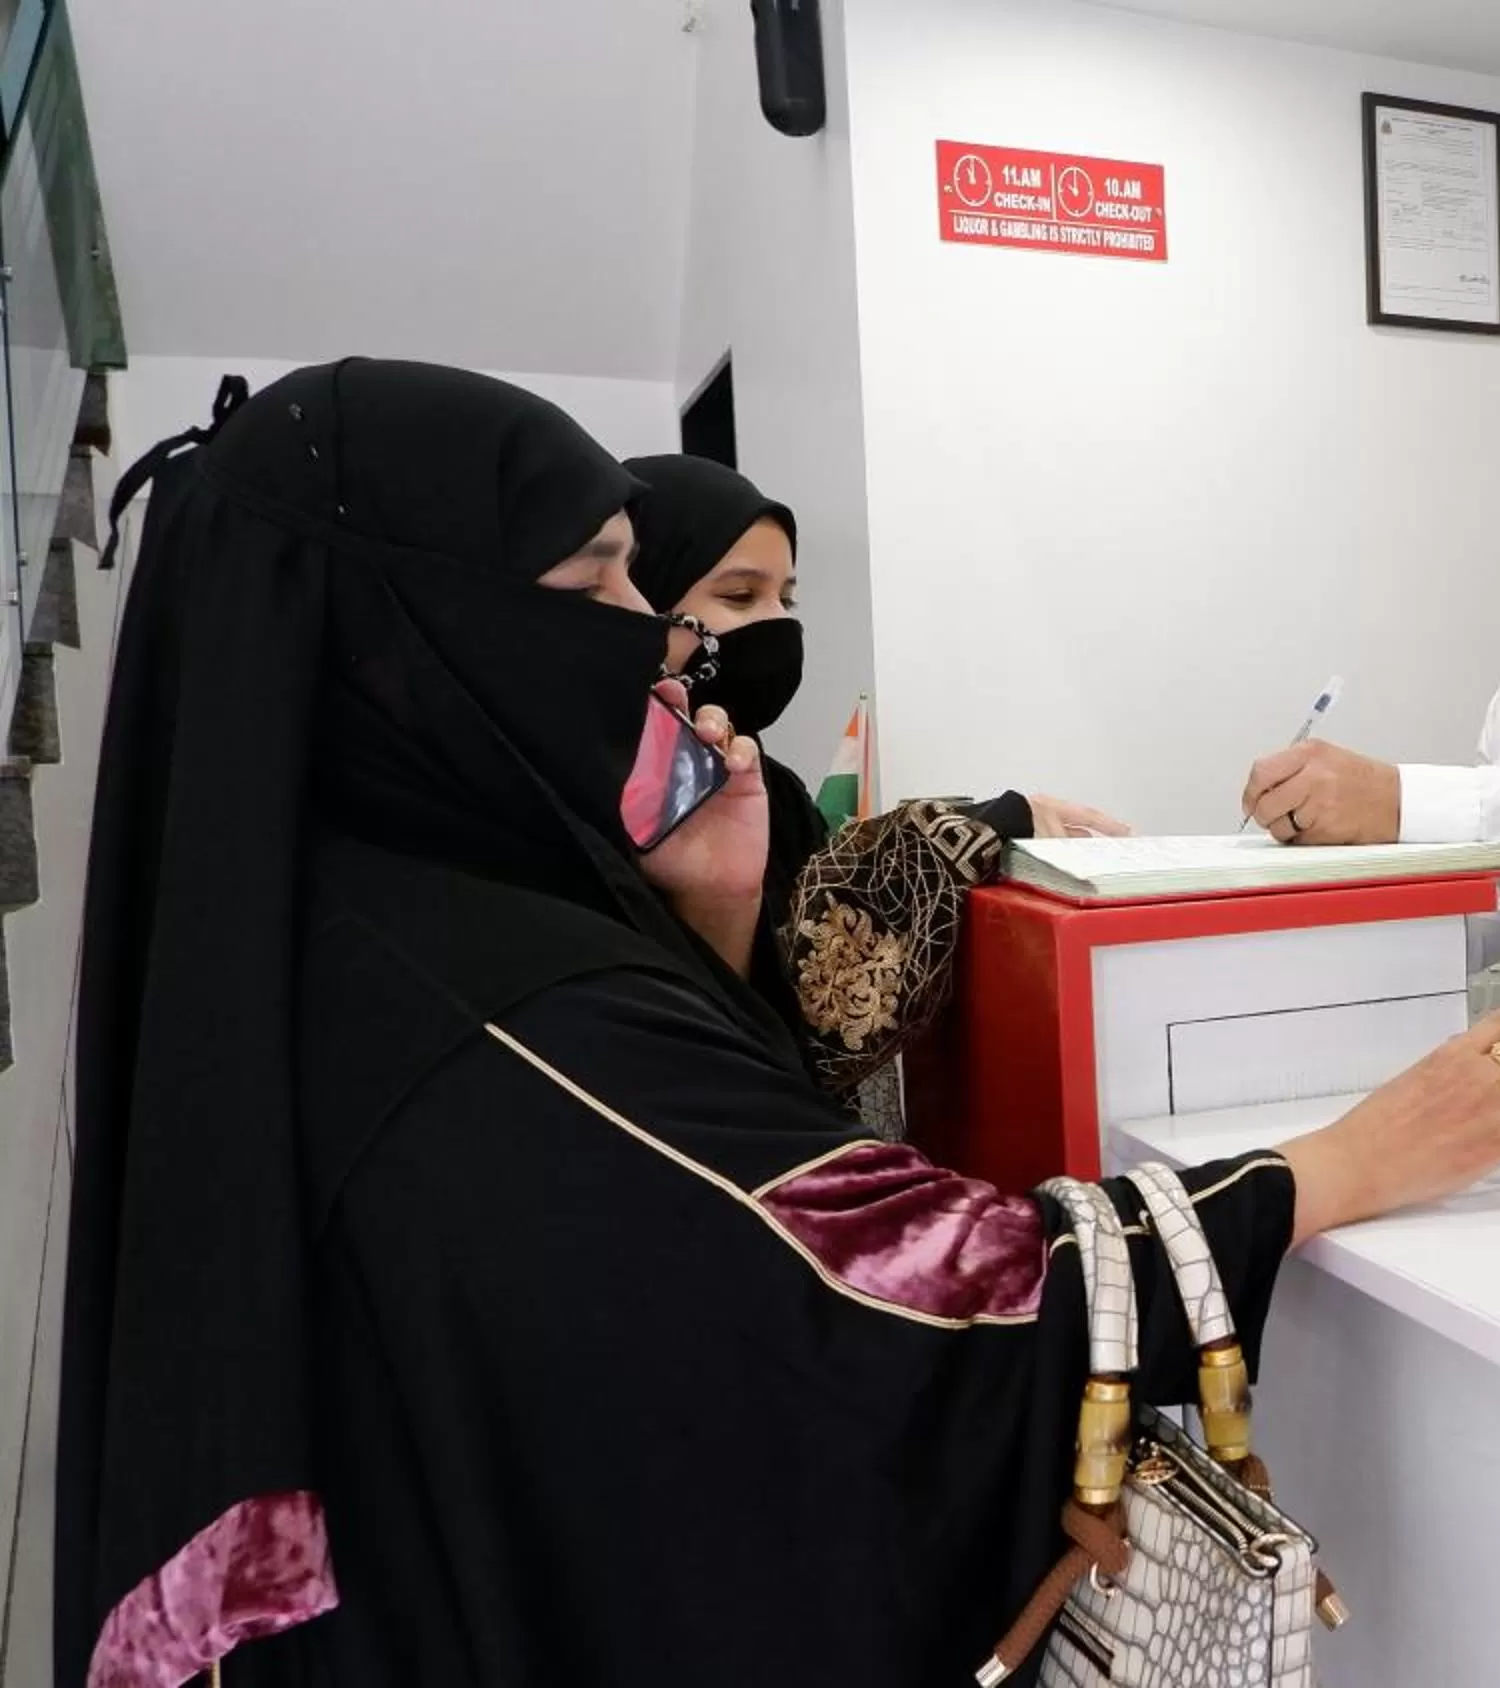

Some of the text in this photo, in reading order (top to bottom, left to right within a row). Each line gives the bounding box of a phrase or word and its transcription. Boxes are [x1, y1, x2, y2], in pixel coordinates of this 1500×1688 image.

[994, 192, 1051, 213] CHECK-IN
[1095, 201, 1153, 223] CHECK-OUT
[953, 216, 1155, 252] LIQUOR & GAMBLING IS STRICTLY PROHIBITED
